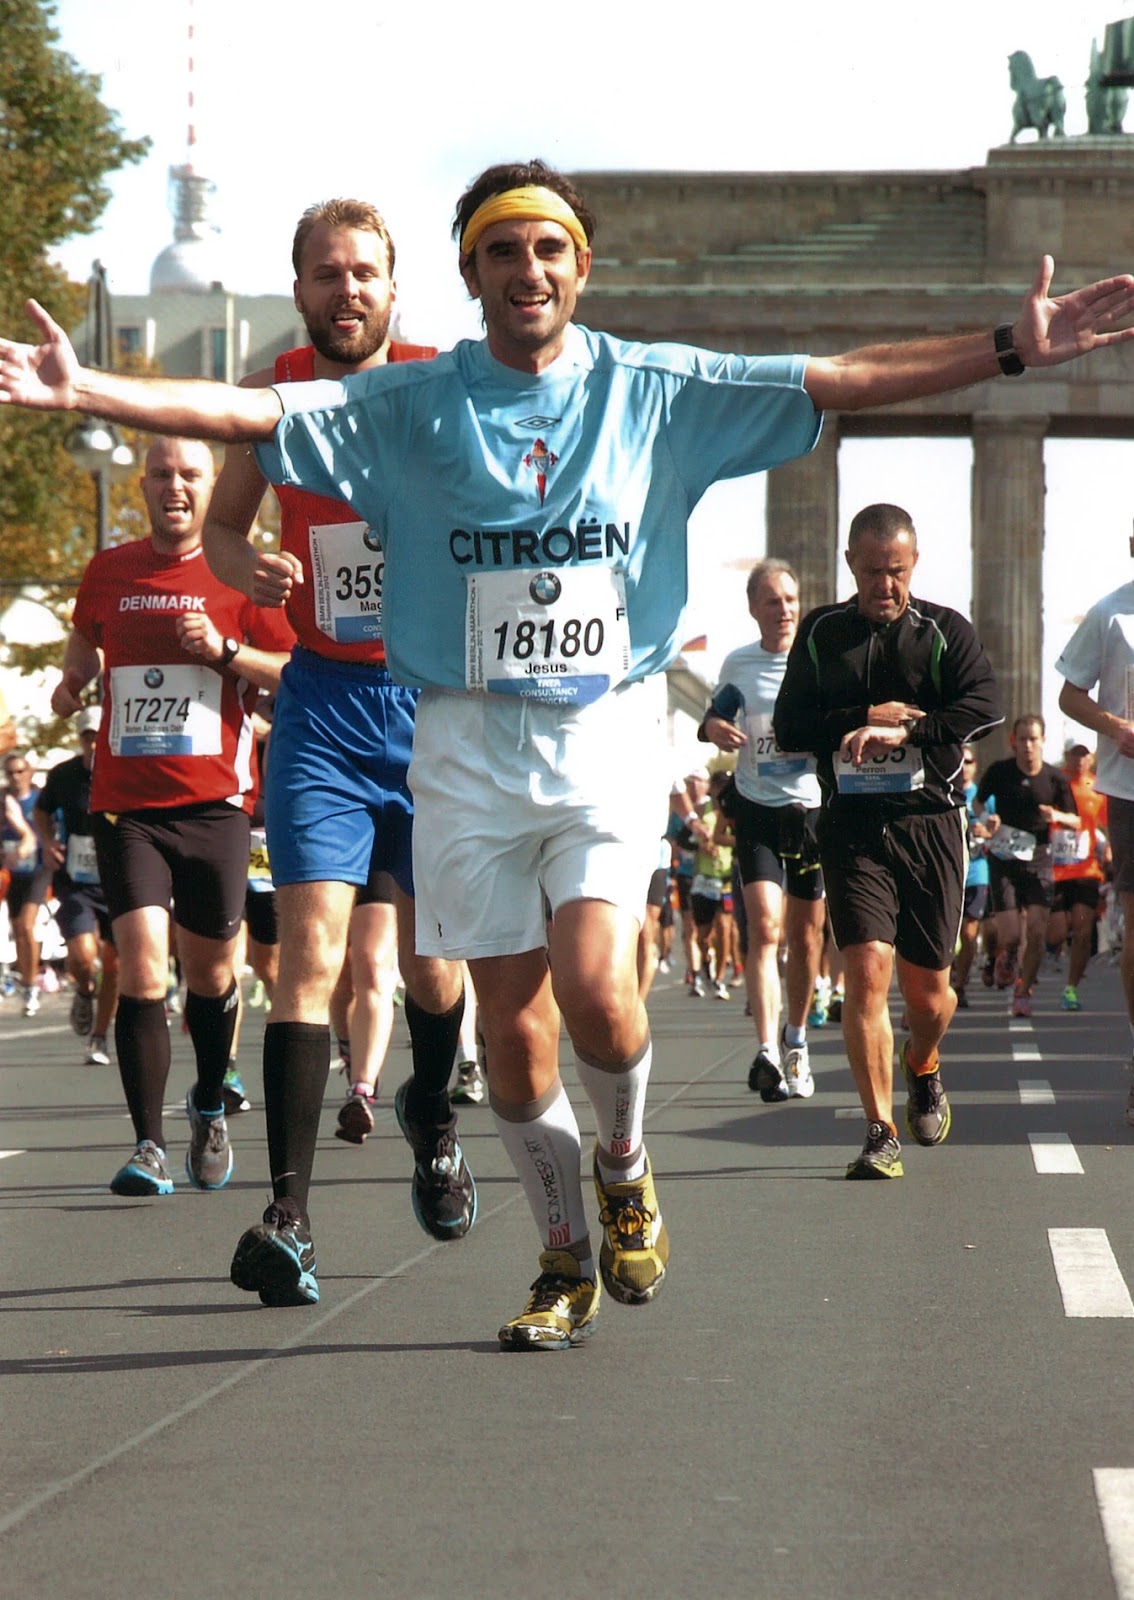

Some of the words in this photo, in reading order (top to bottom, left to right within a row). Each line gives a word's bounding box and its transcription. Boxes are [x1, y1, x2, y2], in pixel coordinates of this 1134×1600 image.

[450, 517, 630, 565] CITROËN
[119, 595, 206, 612] DENMARK
[616, 607, 625, 621] F
[494, 618, 604, 660] 18180
[525, 662, 567, 674] Jesus
[520, 687, 578, 698] CONSULTANCY
[124, 697, 191, 723] 17274
